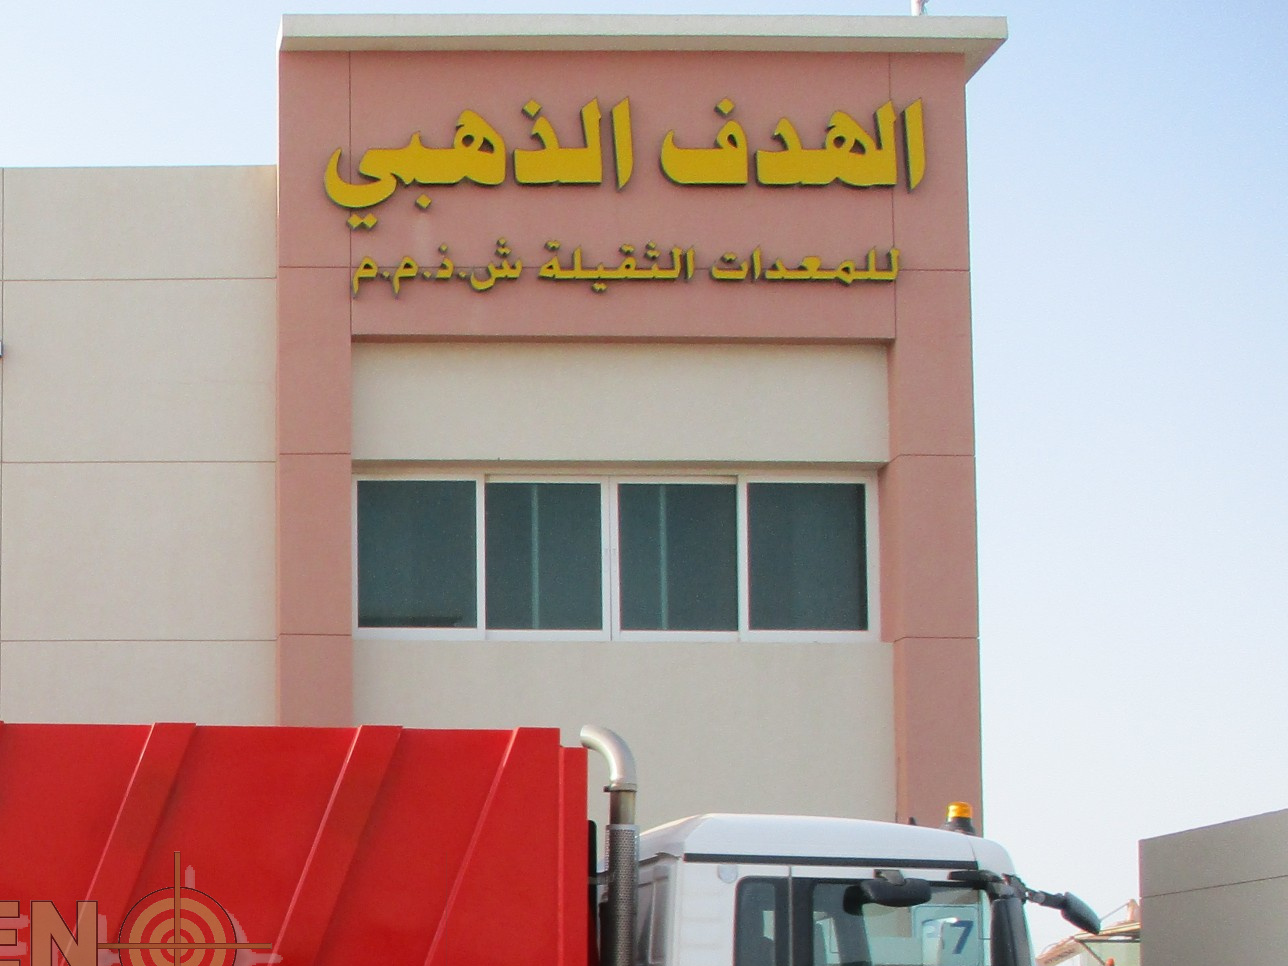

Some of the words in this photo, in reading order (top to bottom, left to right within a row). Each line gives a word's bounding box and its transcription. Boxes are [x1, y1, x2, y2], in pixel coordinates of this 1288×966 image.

[323, 96, 634, 231] الذهبي
[660, 97, 927, 193] الهدف
[538, 239, 696, 293] الثقيلة
[710, 244, 900, 284] للمعدات
